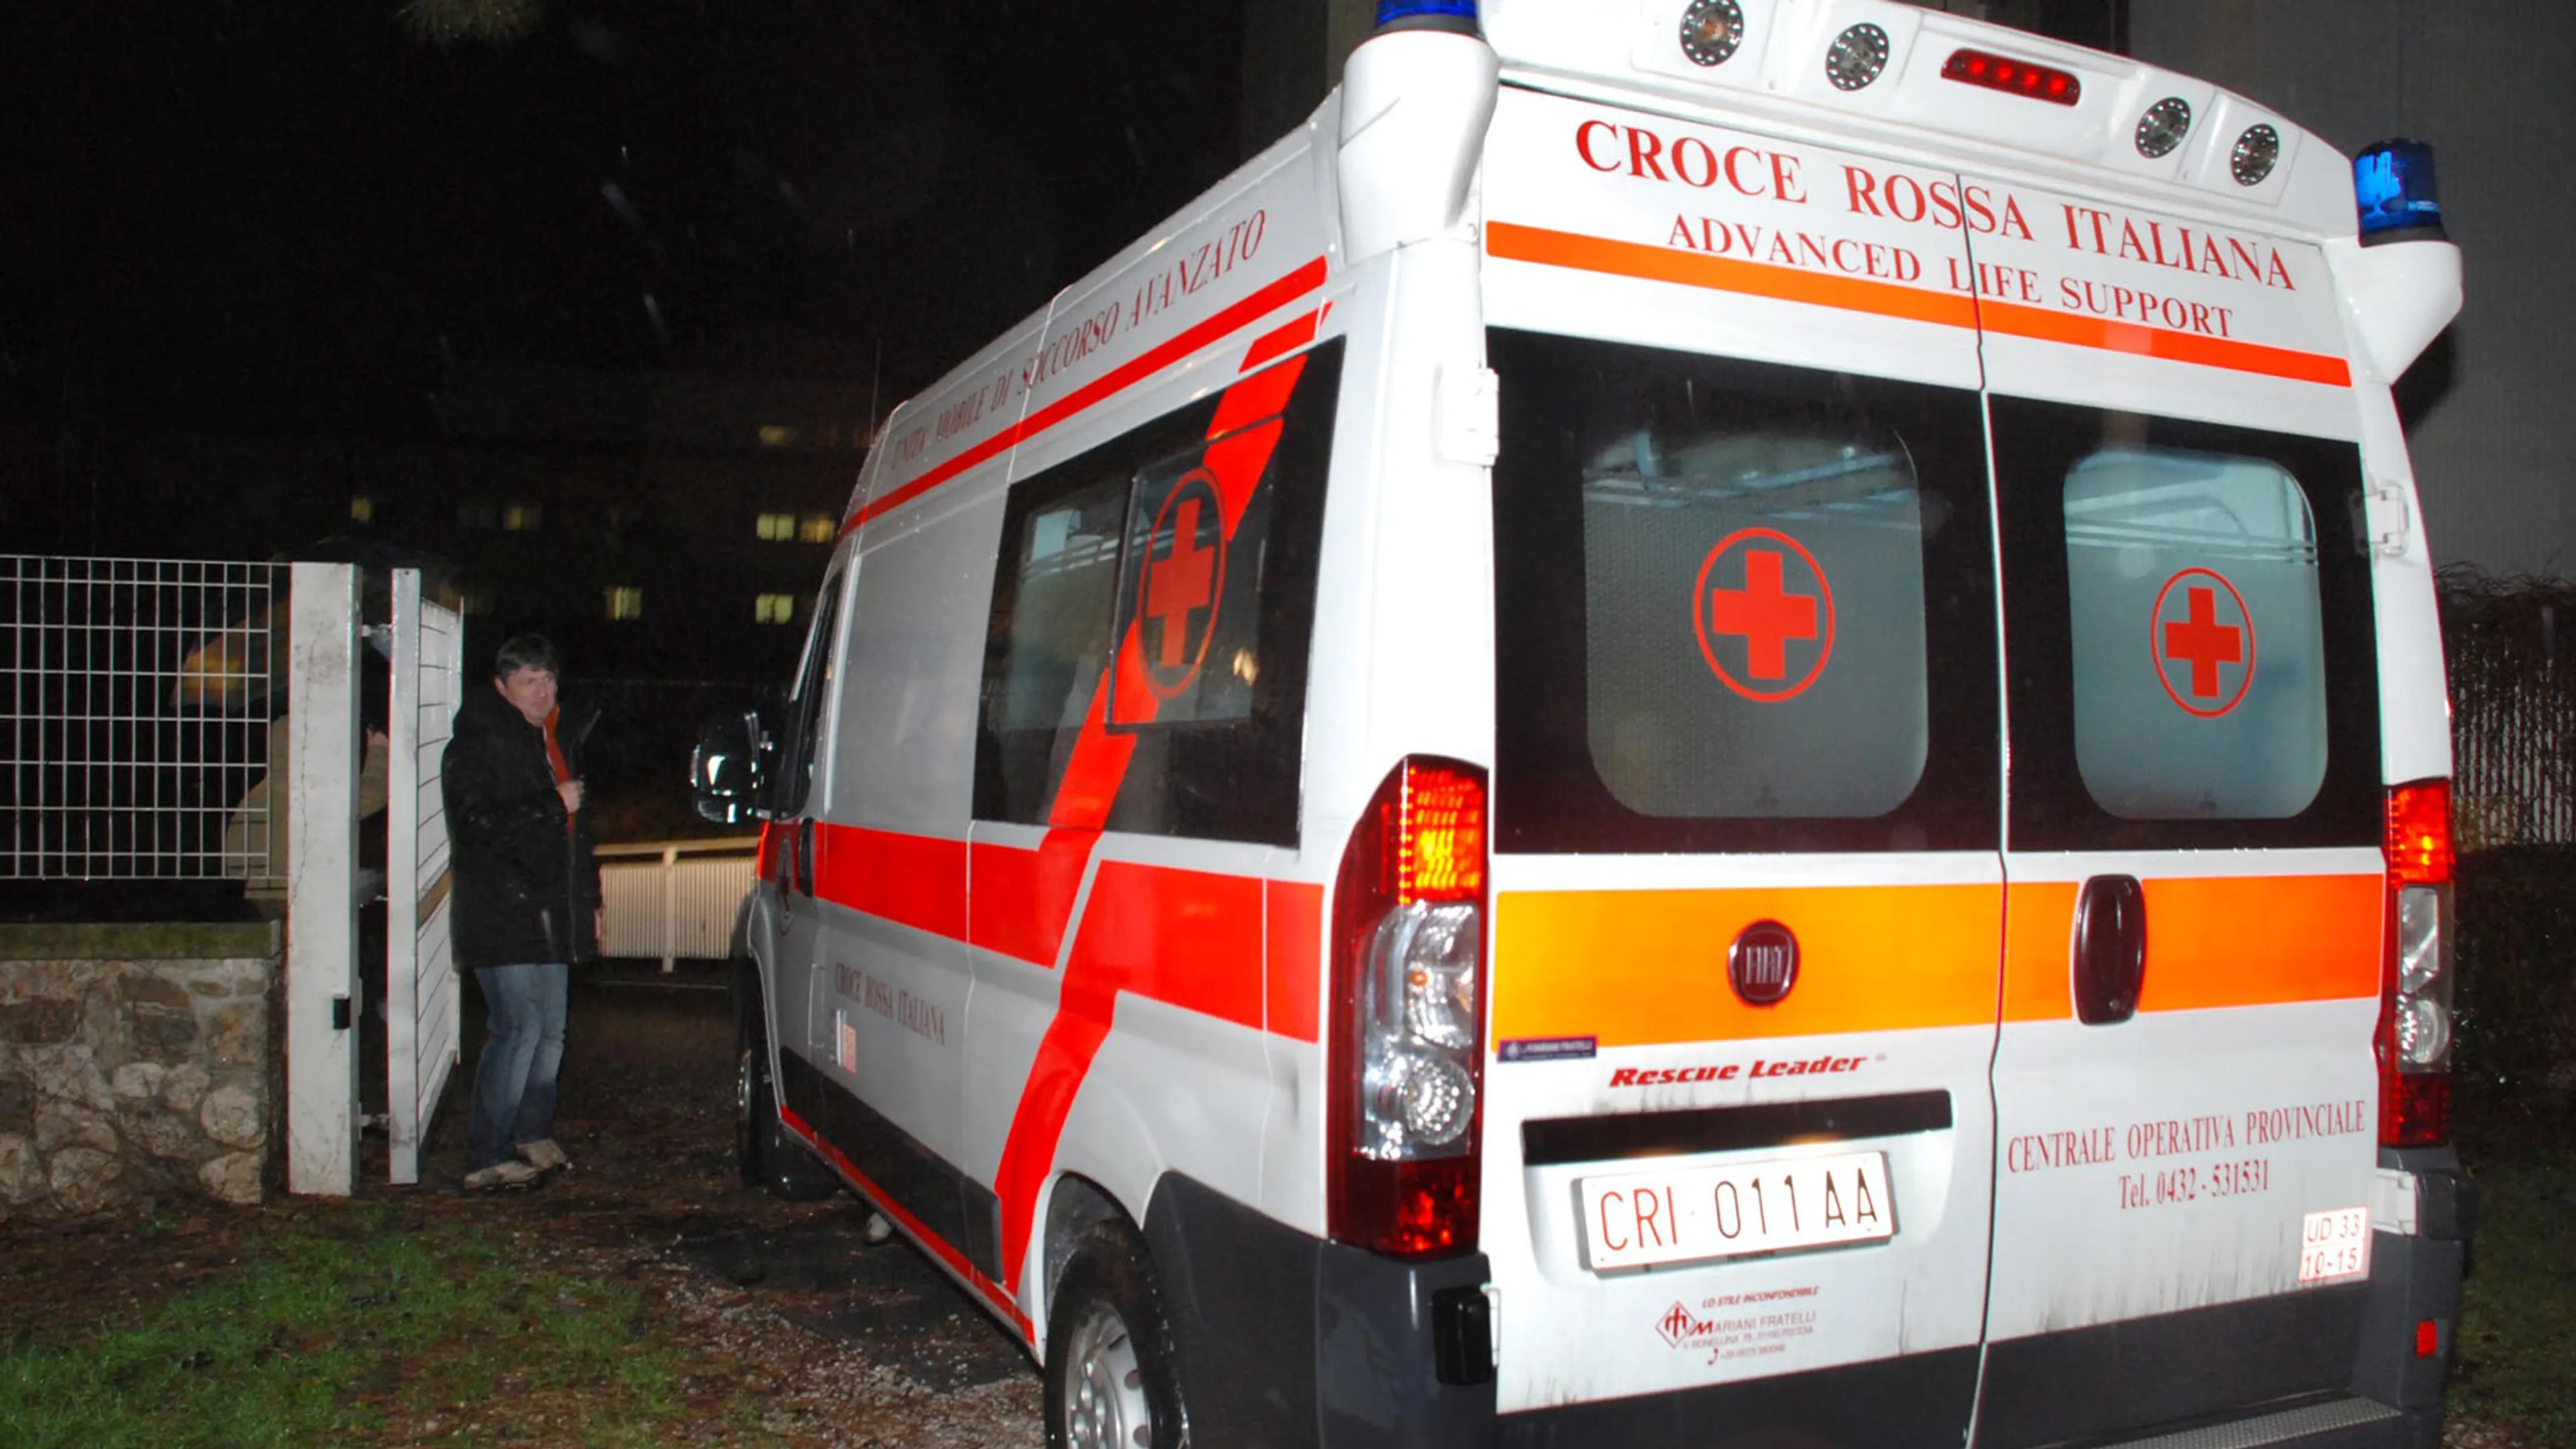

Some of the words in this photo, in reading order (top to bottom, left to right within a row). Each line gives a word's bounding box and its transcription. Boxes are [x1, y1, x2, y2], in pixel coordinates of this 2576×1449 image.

[1575, 119, 1808, 205] CROCE
[1846, 164, 2034, 241] ROSSA
[2063, 205, 2297, 292] ITALIANA
[1667, 213, 1921, 282] ADVANCED
[1947, 256, 2043, 304] LIFE
[2060, 277, 2233, 339] SUPPORT
[990, 368, 1014, 413] DI
[1015, 301, 1120, 397] SOCCORSO
[1124, 209, 1267, 333] AVANZATO
[1609, 1065, 1740, 1087] Rescue
[1748, 1055, 1868, 1079] Leader
[2007, 1126, 2116, 1174] CENTRALE
[2127, 1115, 2235, 1159] OPERATIVA
[2245, 1099, 2367, 1146] PROVINCIALE
[2118, 1173, 2150, 1210] Tel.
[1599, 1185, 1678, 1252] CRI
[2307, 1217, 2332, 1242] UD
[2339, 1214, 2360, 1239] 33
[2306, 1247, 2357, 1277] 10-15
[1702, 1297, 1715, 1308] LO
[1688, 1318, 1757, 1337] MARIANI
[1760, 1310, 1817, 1328] FRATELLI
